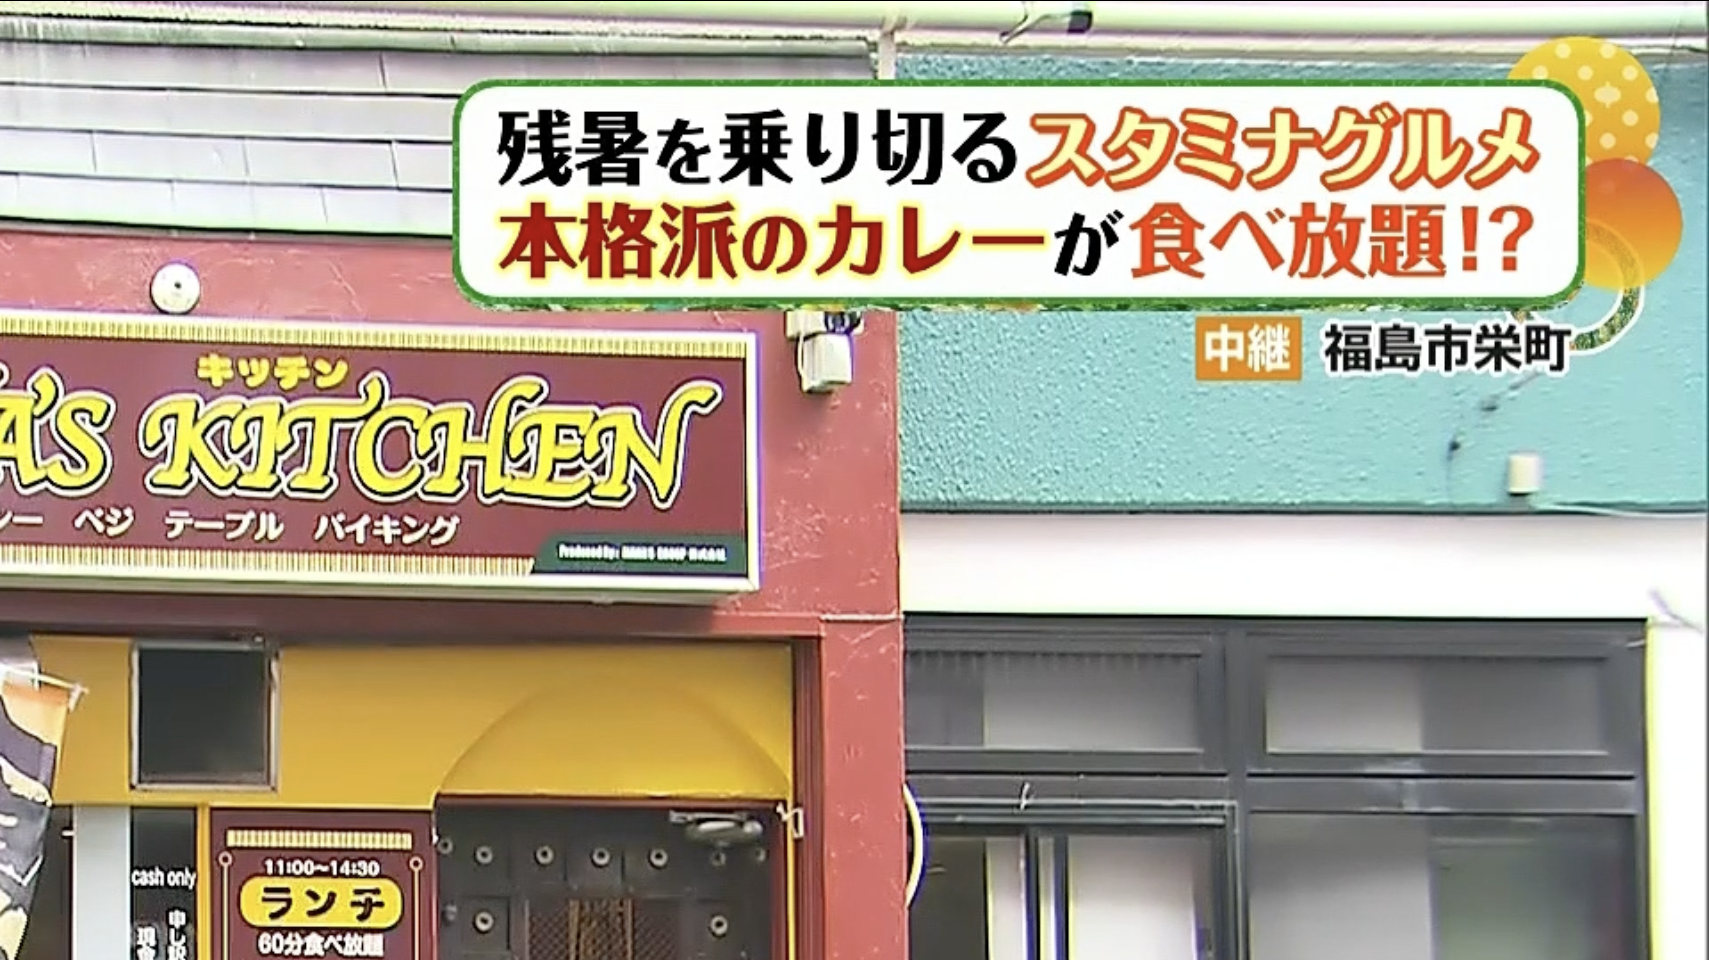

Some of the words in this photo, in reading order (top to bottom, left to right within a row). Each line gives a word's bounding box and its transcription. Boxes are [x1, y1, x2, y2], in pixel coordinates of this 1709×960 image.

[197, 352, 349, 390] キッチン
[143, 376, 718, 505] KITCHEN
[164, 509, 284, 542] テーブル
[313, 513, 460, 546] バイキング
[132, 866, 164, 889] cash
[167, 867, 197, 891] only
[261, 886, 386, 922] ランチ
